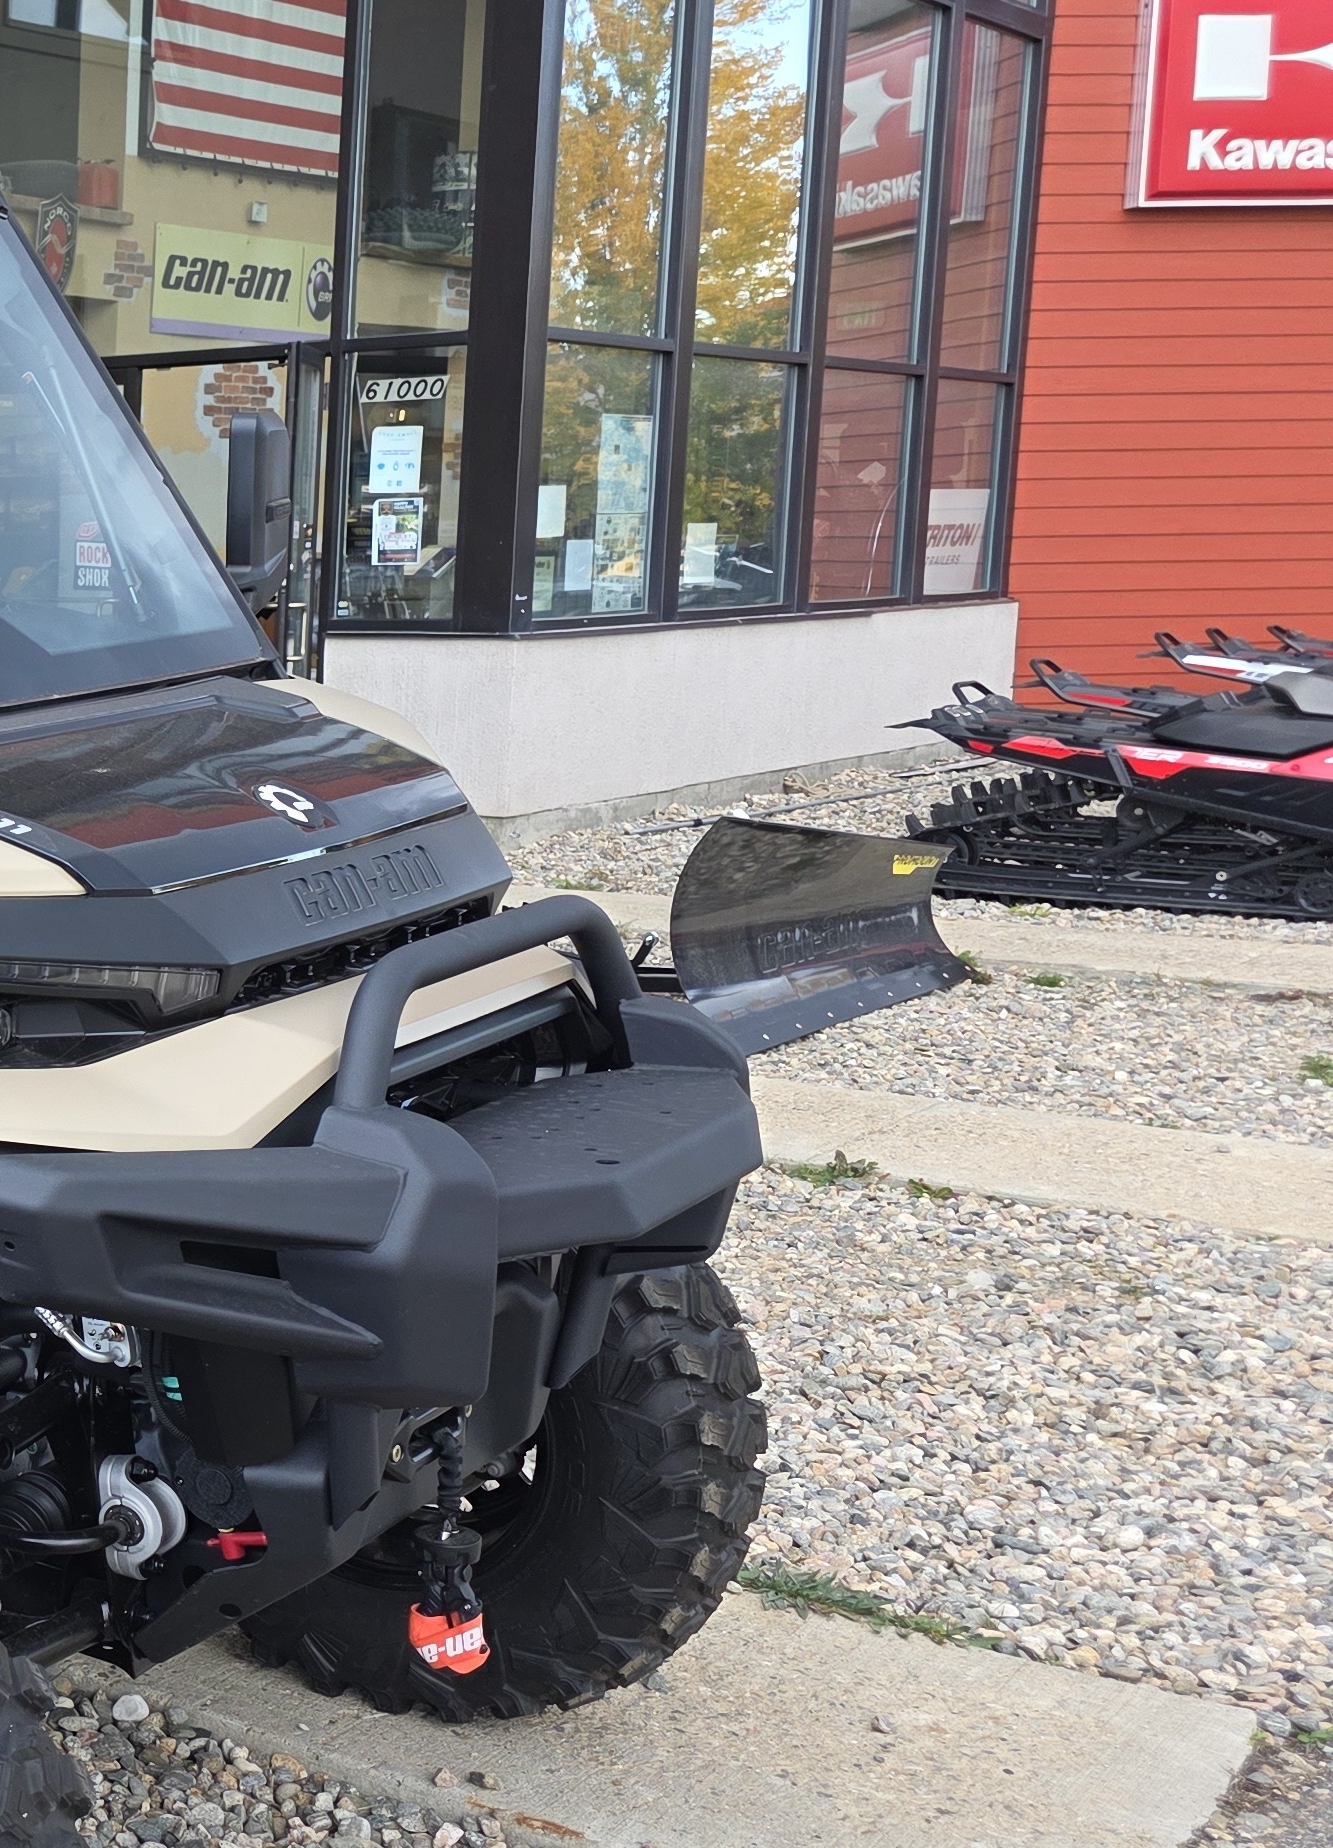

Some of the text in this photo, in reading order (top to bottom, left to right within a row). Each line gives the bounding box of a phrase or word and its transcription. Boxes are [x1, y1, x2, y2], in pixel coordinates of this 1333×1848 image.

[365, 378, 445, 400] 61000
[78, 544, 109, 565] ROCK
[77, 567, 109, 587] SHOX
[283, 844, 445, 928] can-am
